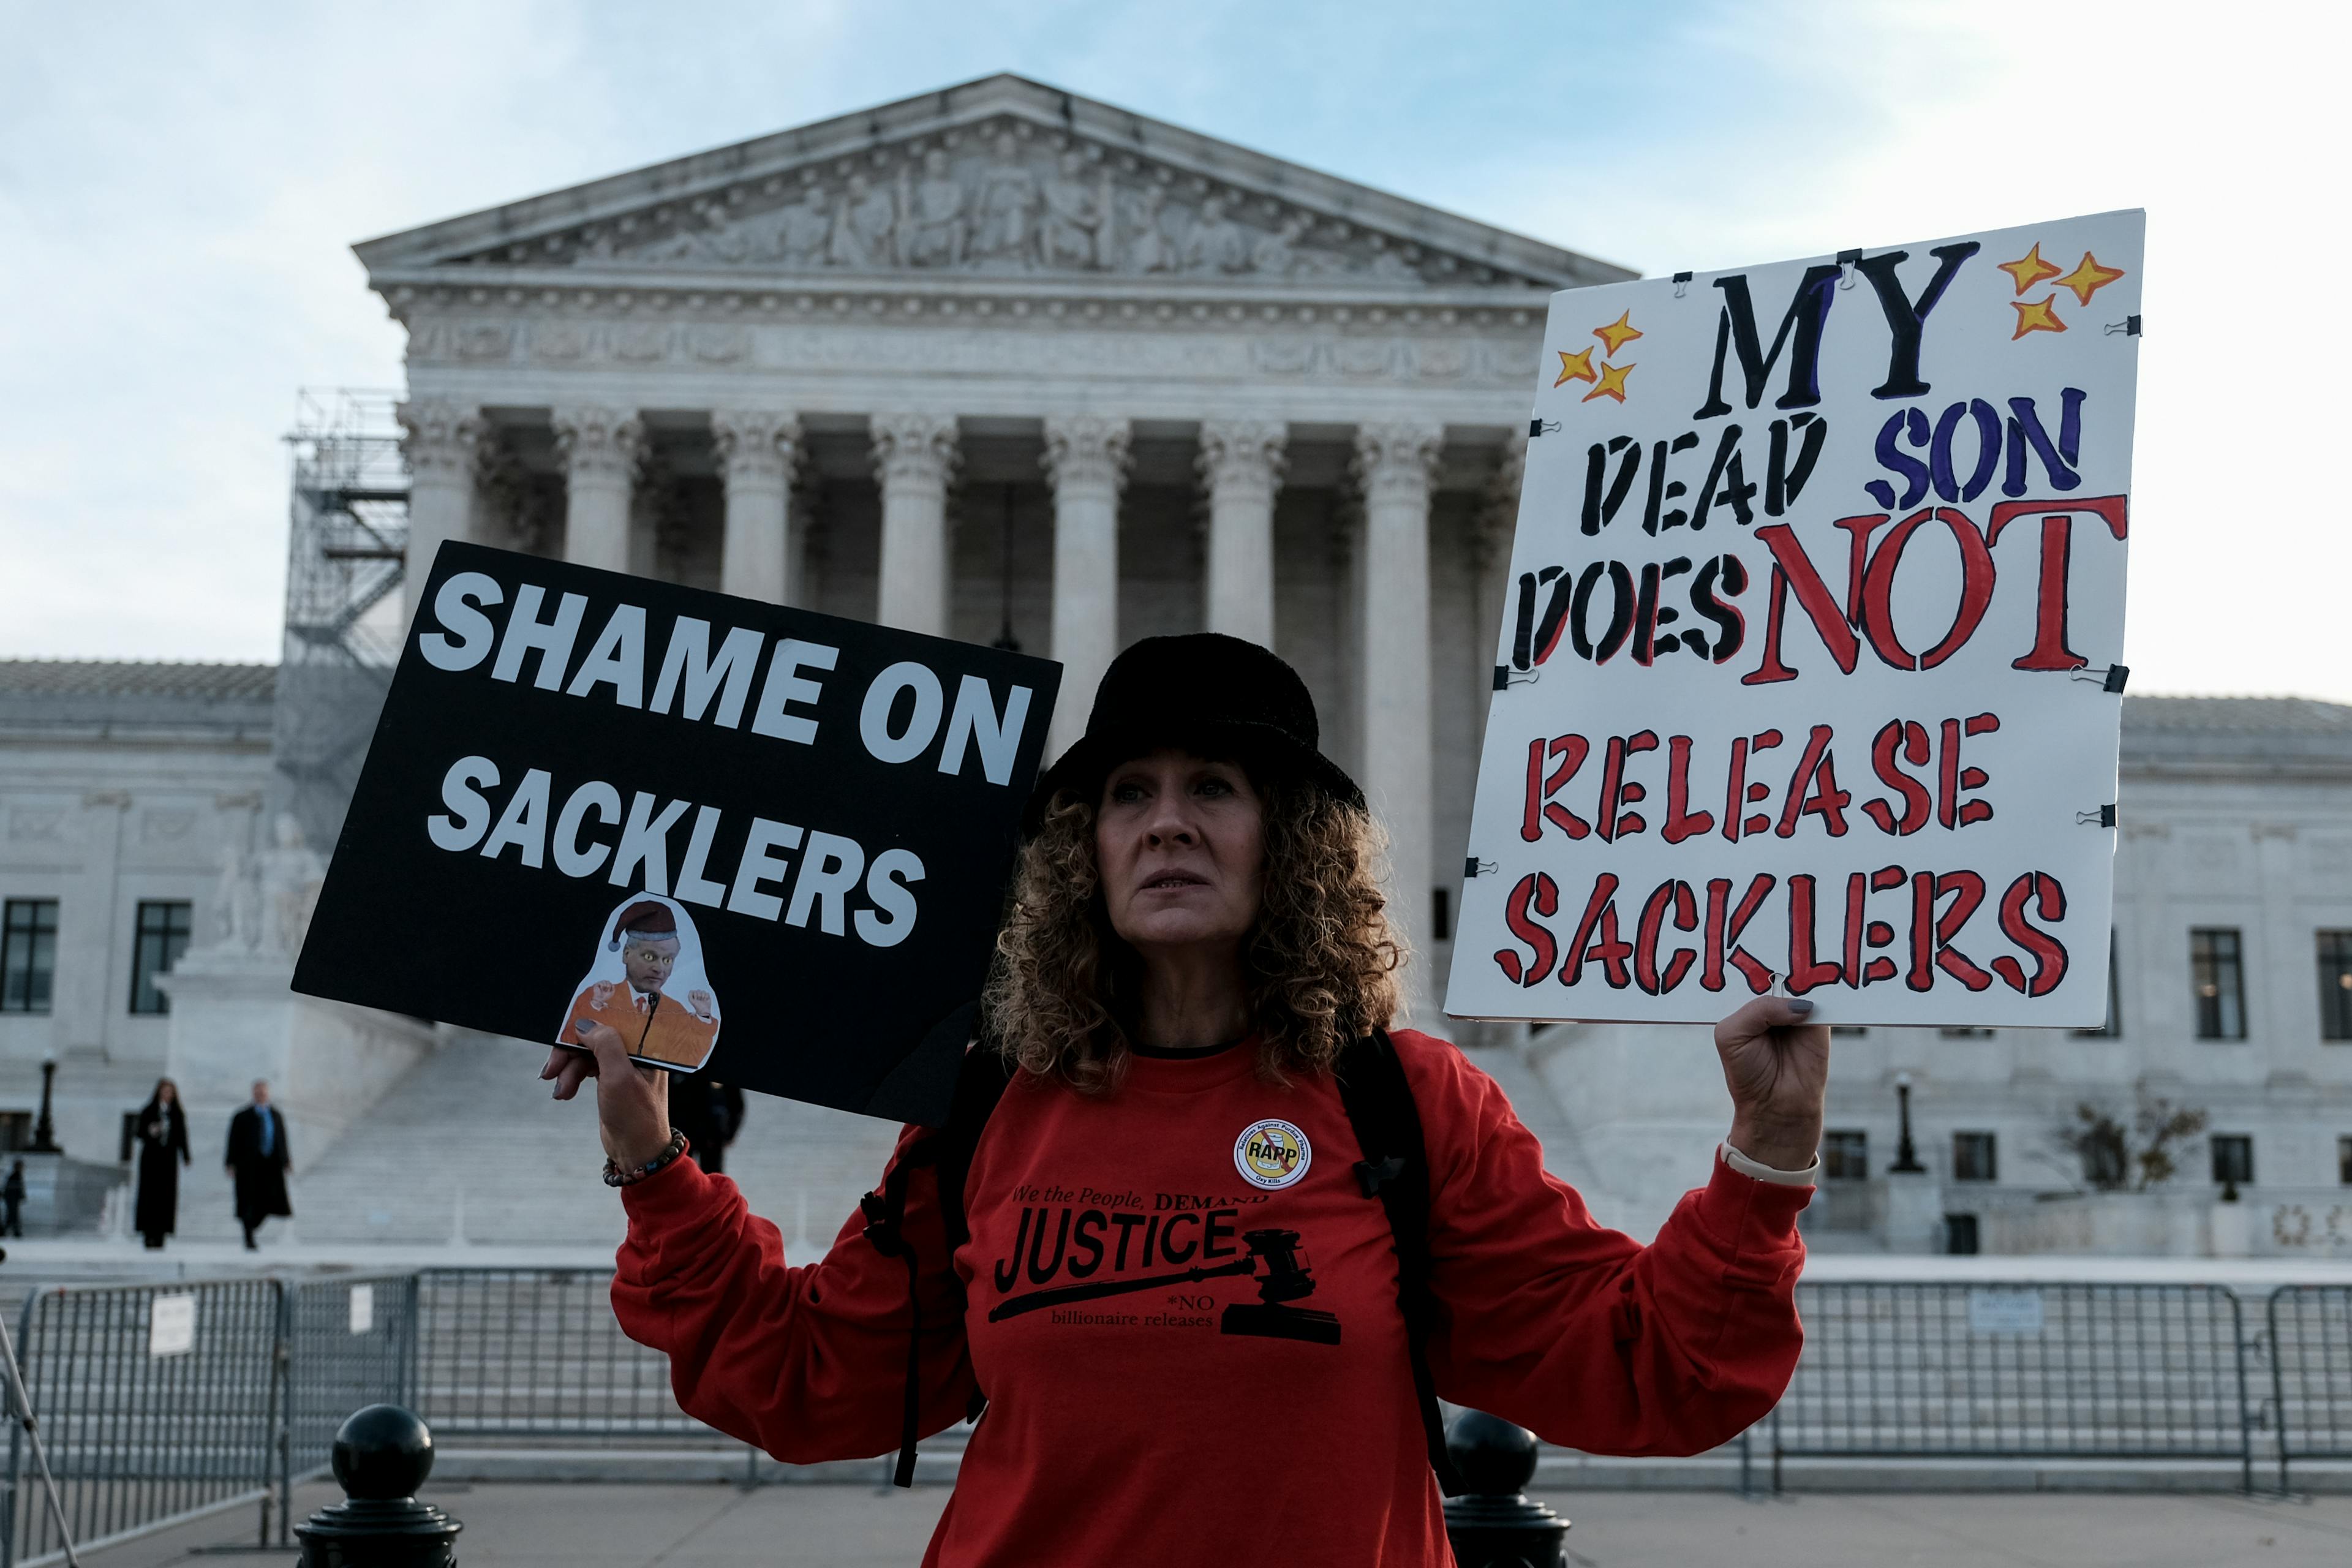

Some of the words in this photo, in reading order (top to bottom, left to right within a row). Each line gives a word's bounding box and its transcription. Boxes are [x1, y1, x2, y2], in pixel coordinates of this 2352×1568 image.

[1693, 241, 1980, 420] MY
[1580, 412, 1827, 537] DEAD
[1864, 387, 2087, 510] SON
[1512, 554, 1749, 670] DOES
[1741, 494, 2128, 686] NOT
[419, 571, 840, 745] SHAME
[859, 661, 1033, 786] ON
[1520, 712, 2000, 844] RELEASE
[427, 756, 925, 948] SACKLERS
[1493, 864, 2069, 998] SACKLERS
[1012, 1185, 1039, 1202] We
[1043, 1186, 1074, 1202] the
[1078, 1187, 1145, 1210] People,
[1153, 1193, 1270, 1211] DEMAND
[1239, 1129, 1256, 1150] Relatives
[1281, 1123, 1299, 1139] Purdue
[1248, 1141, 1297, 1163] RAPP
[1256, 1175, 1267, 1185] Oxy
[994, 1207, 1238, 1294] JUSTICE
[1051, 1310, 1139, 1325] billionaire
[1144, 1313, 1213, 1327] releases
